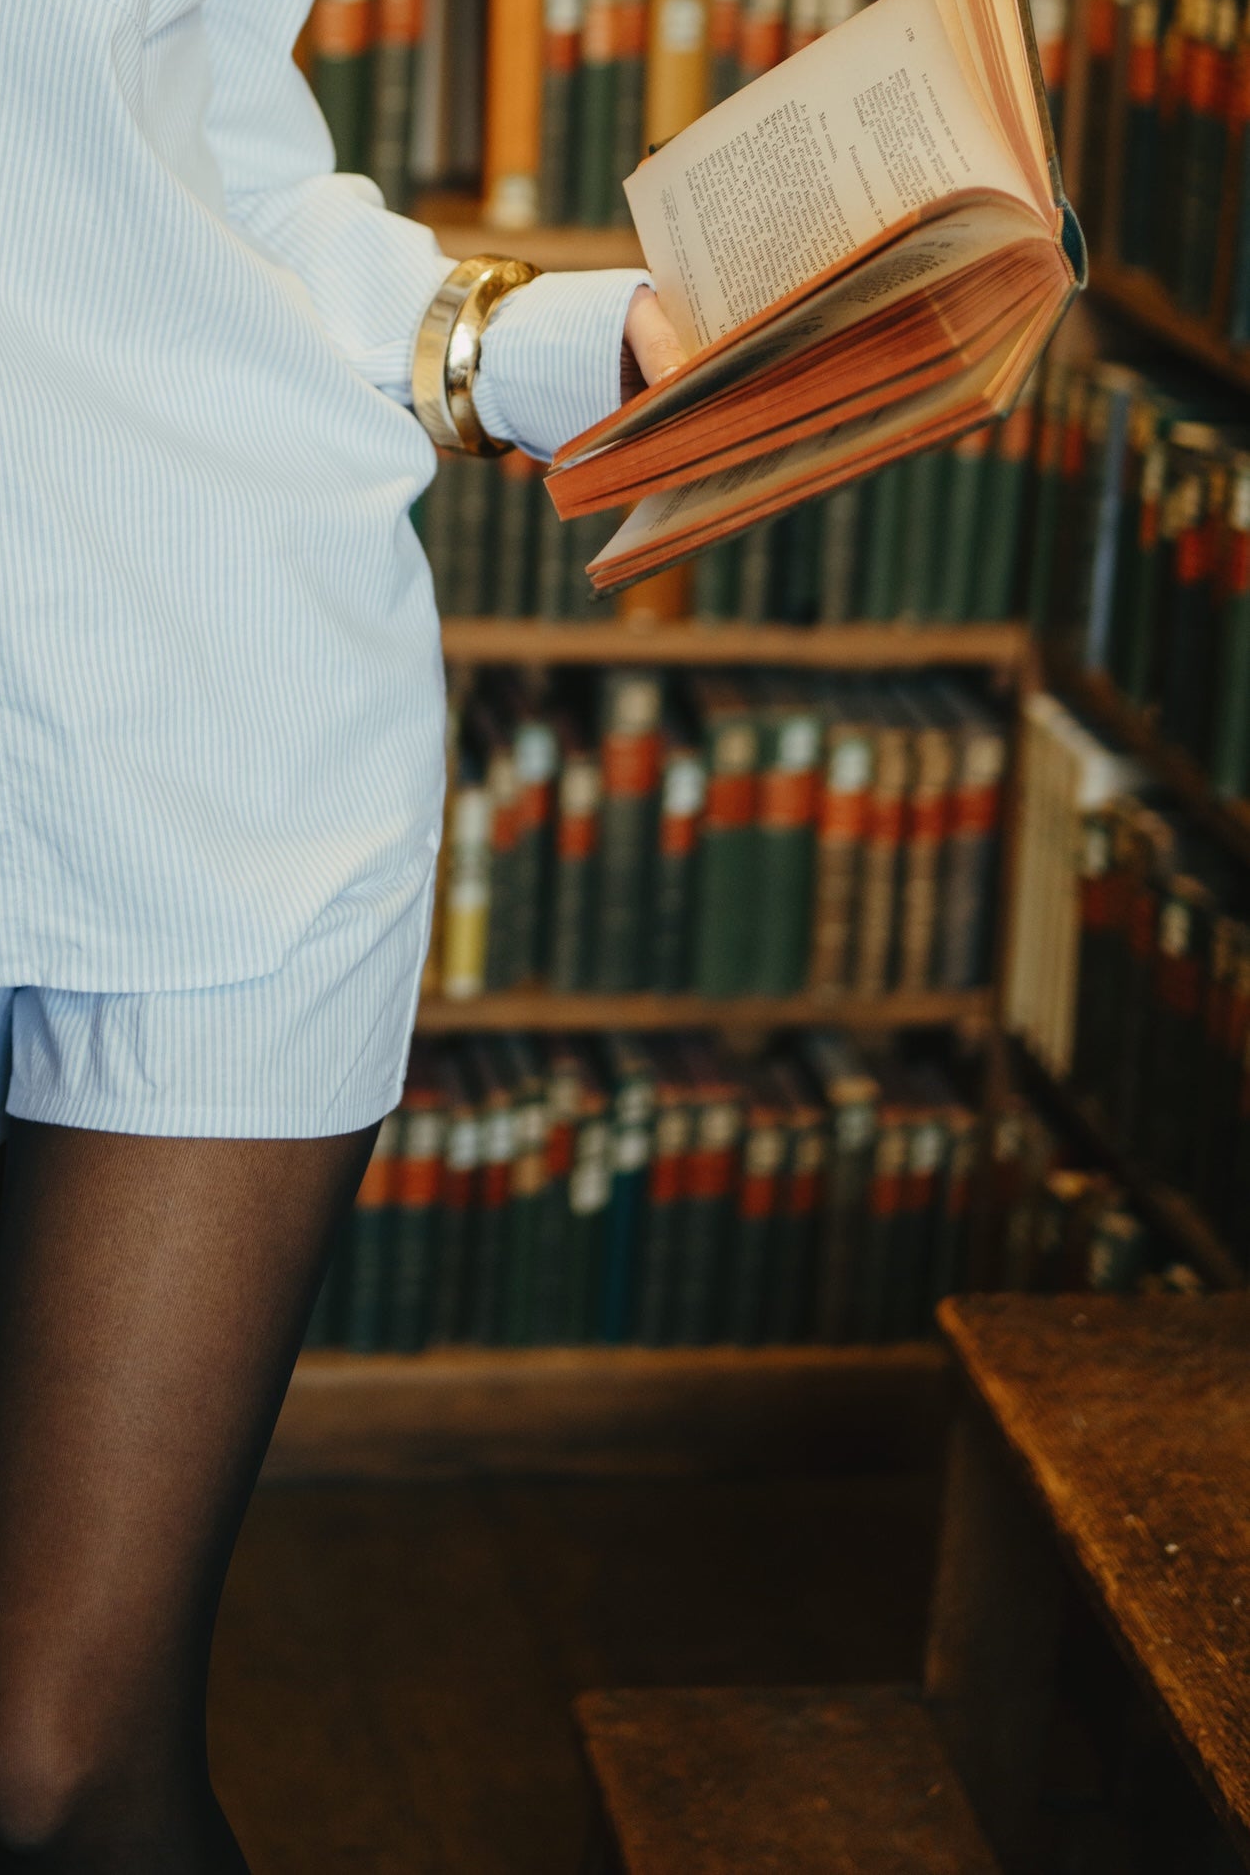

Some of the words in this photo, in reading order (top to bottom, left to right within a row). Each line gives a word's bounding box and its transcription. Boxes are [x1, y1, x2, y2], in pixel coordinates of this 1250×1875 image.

[905, 27, 915, 42] 176
[818, 112, 827, 131] Mon
[825, 134, 837, 163] cousin,
[772, 143, 789, 187] Chancelier
[803, 190, 818, 226] Bouillon
[825, 183, 847, 226] important
[843, 228, 857, 248] pour
[791, 256, 801, 274] tout
